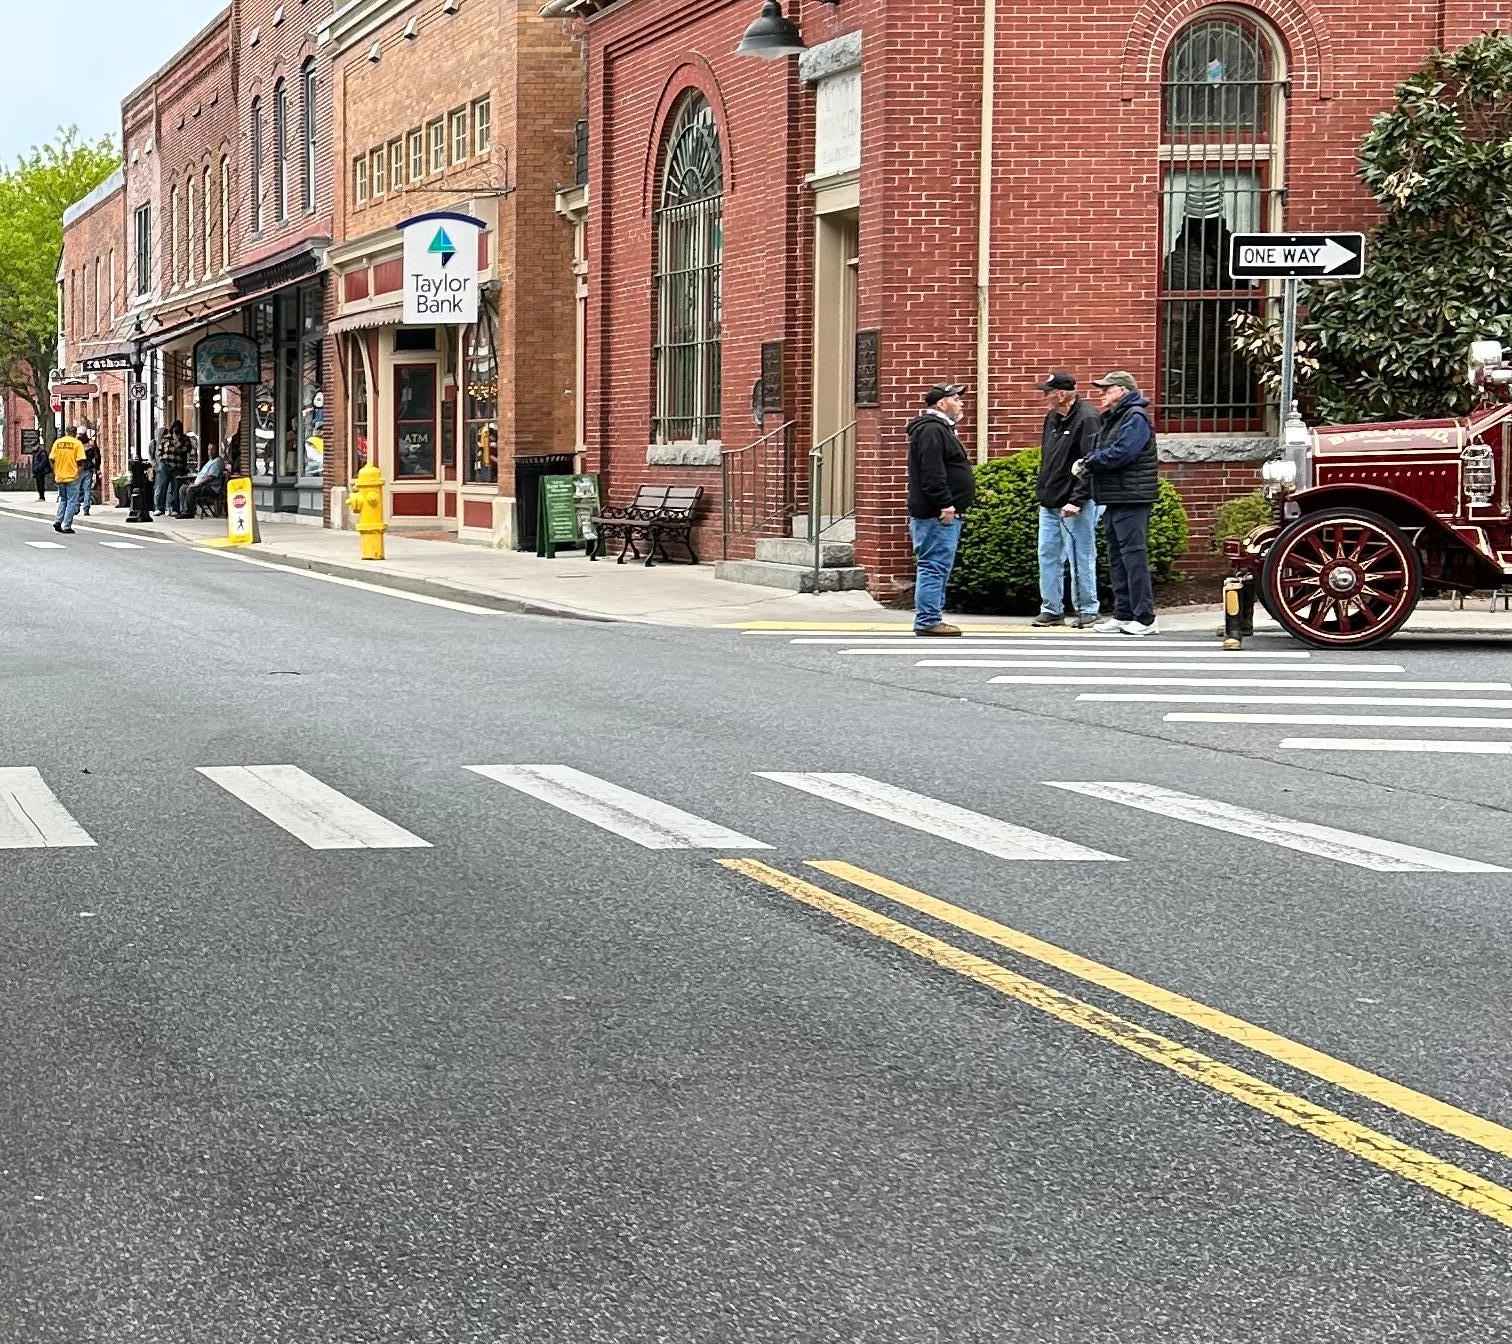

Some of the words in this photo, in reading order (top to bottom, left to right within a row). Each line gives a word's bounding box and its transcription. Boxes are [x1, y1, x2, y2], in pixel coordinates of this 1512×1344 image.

[1244, 248, 1276, 263] ONE
[1283, 248, 1321, 263] WAY
[411, 273, 470, 297] Taylor
[417, 294, 463, 313] Bank
[404, 433, 428, 443] ATM
